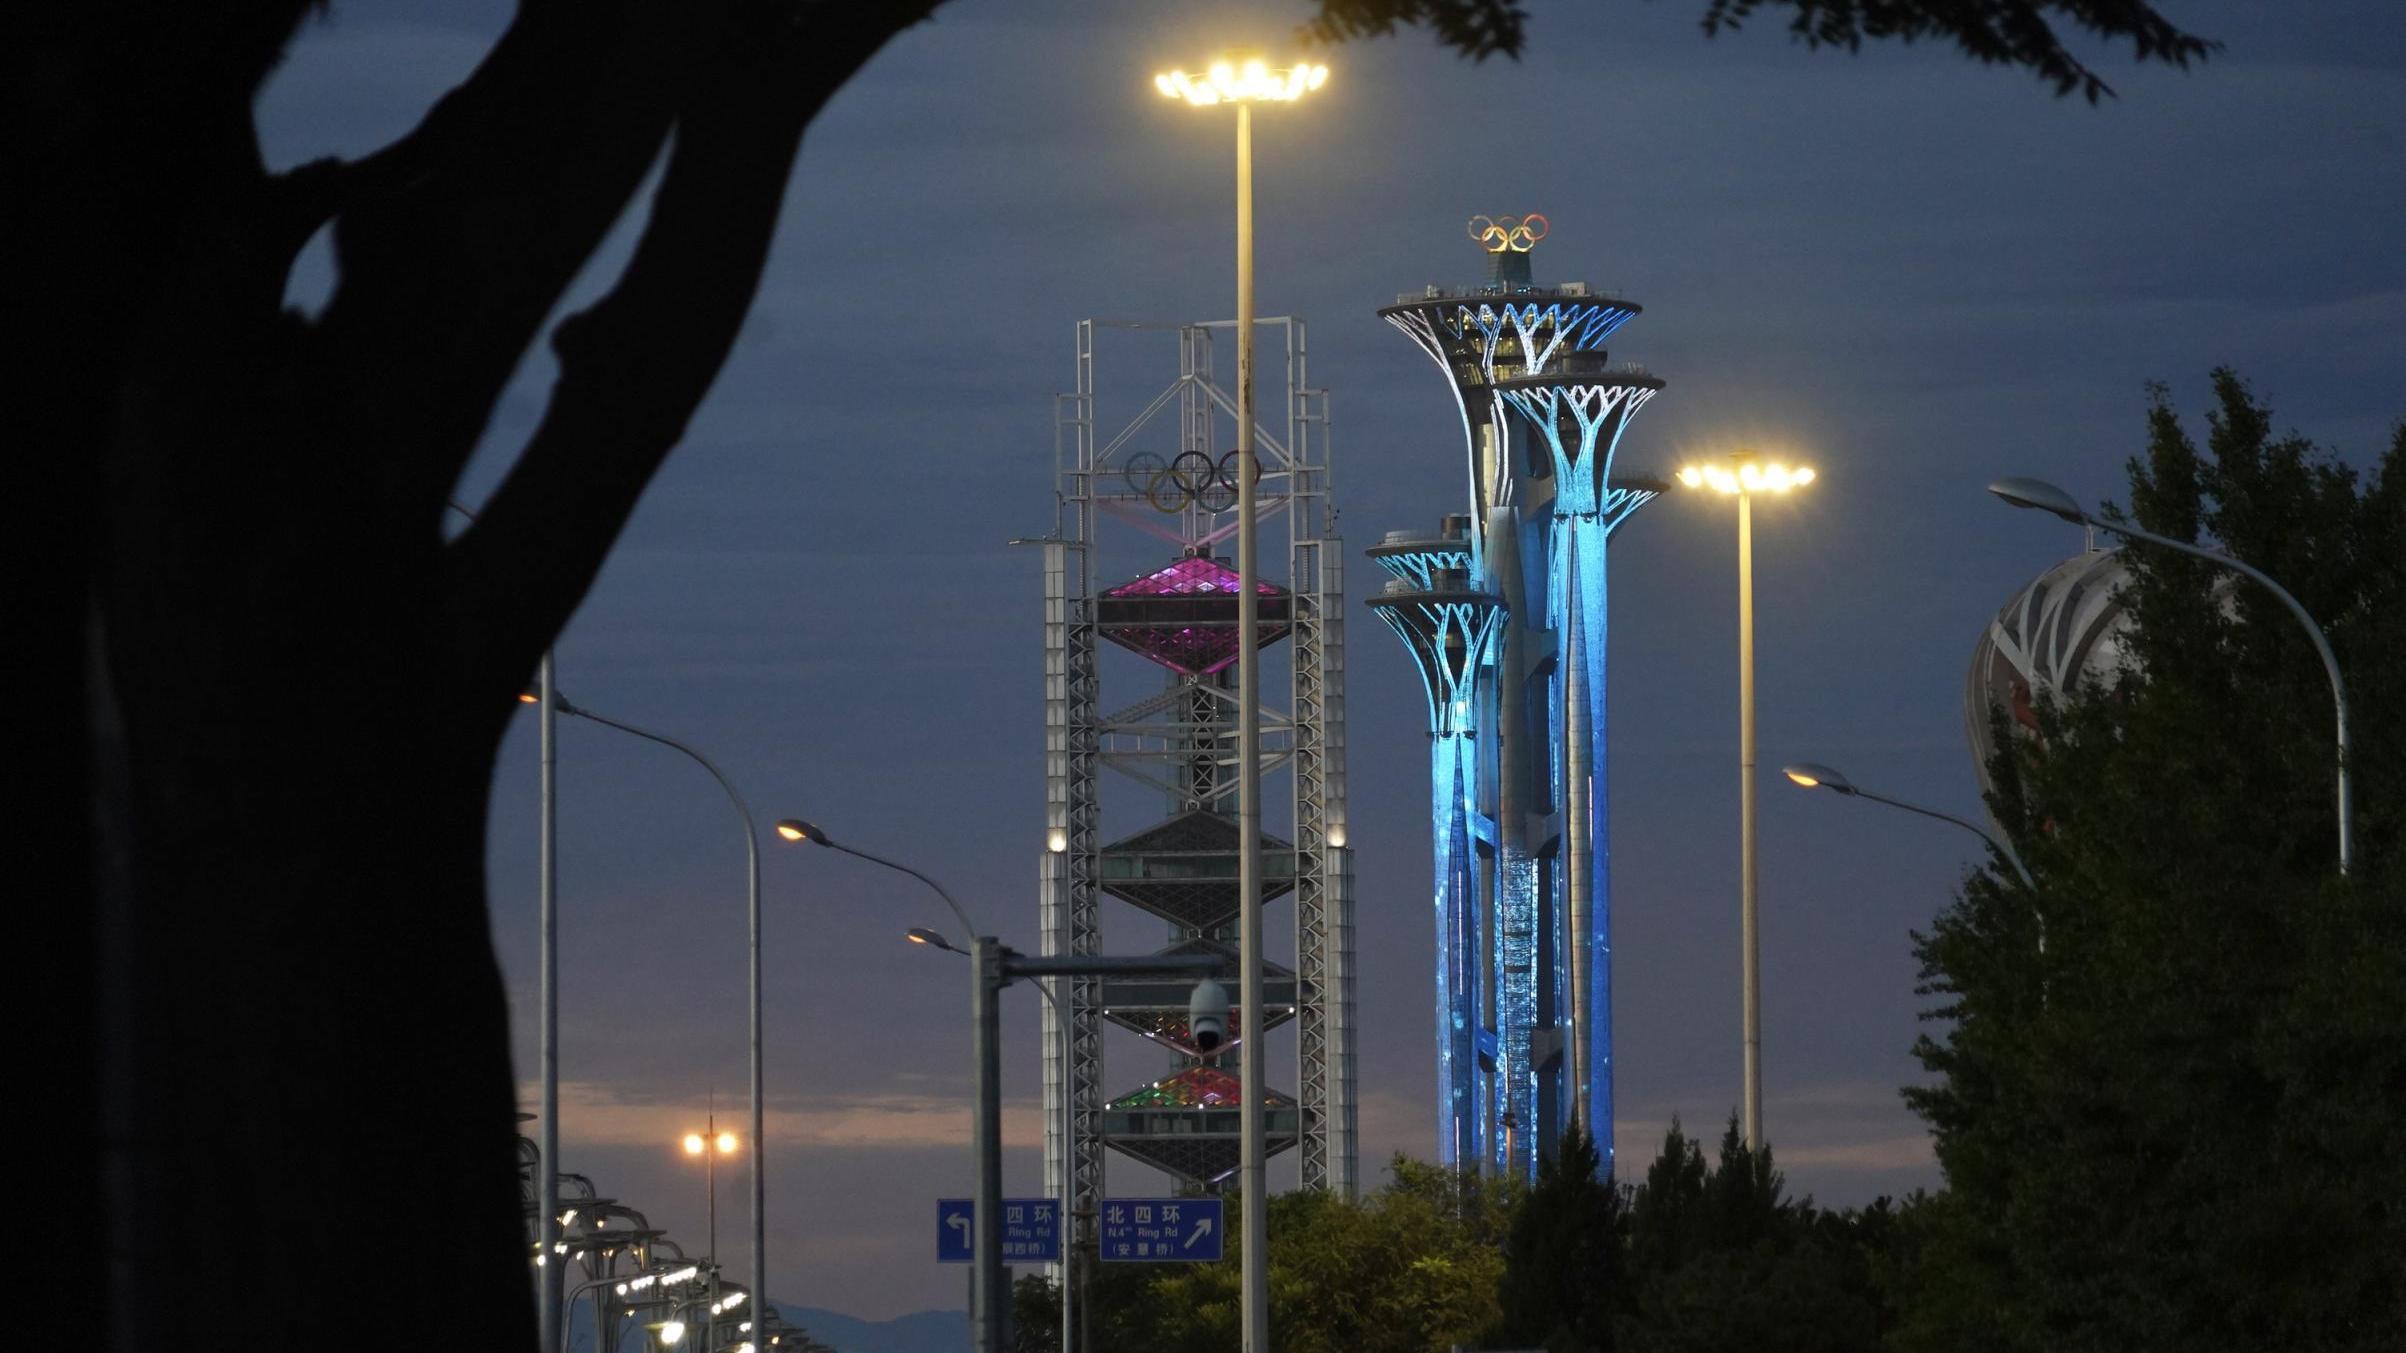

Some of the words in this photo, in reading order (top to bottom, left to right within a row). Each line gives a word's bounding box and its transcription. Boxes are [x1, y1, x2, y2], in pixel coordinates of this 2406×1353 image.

[1107, 1206, 1180, 1224] 北四环
[1008, 1227, 1031, 1239] Ring
[1037, 1227, 1050, 1237] Rd
[1138, 1227, 1160, 1239] Ring
[1165, 1227, 1178, 1237] Rd
